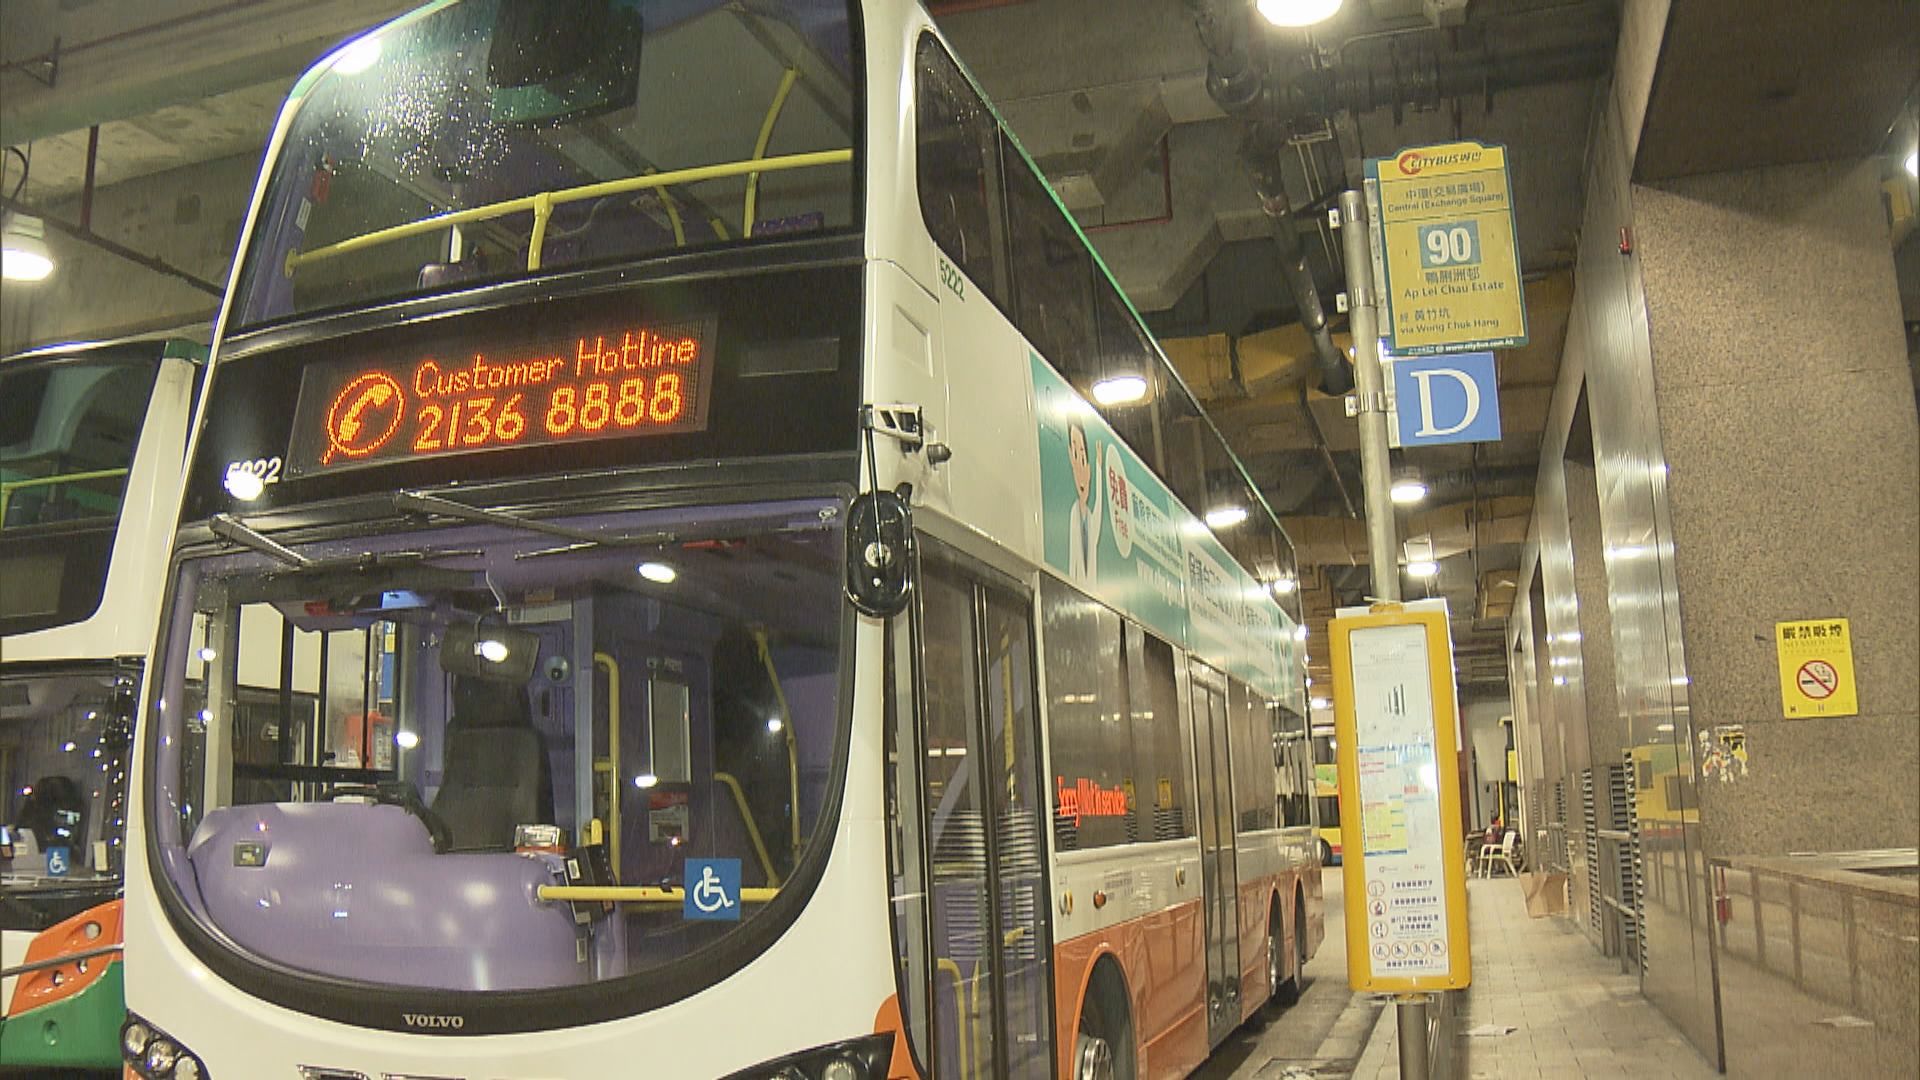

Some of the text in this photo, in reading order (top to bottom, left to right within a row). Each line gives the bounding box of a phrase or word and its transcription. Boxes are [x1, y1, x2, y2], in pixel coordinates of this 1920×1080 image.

[1388, 193, 1504, 213] Central (Exchange Square)
[1427, 228, 1472, 265] 90
[940, 258, 965, 303] 5222
[1404, 280, 1505, 300] Ap Lei Chau Estate
[1416, 323, 1445, 334] Wong
[1447, 320, 1472, 330] Chuk
[1473, 317, 1499, 328] Hang
[414, 330, 696, 397] Customer Hotline
[414, 372, 681, 451] 2136 8888
[1410, 368, 1480, 437] D
[1108, 465, 1129, 512] 免費
[403, 1014, 463, 1028] VOLVO
